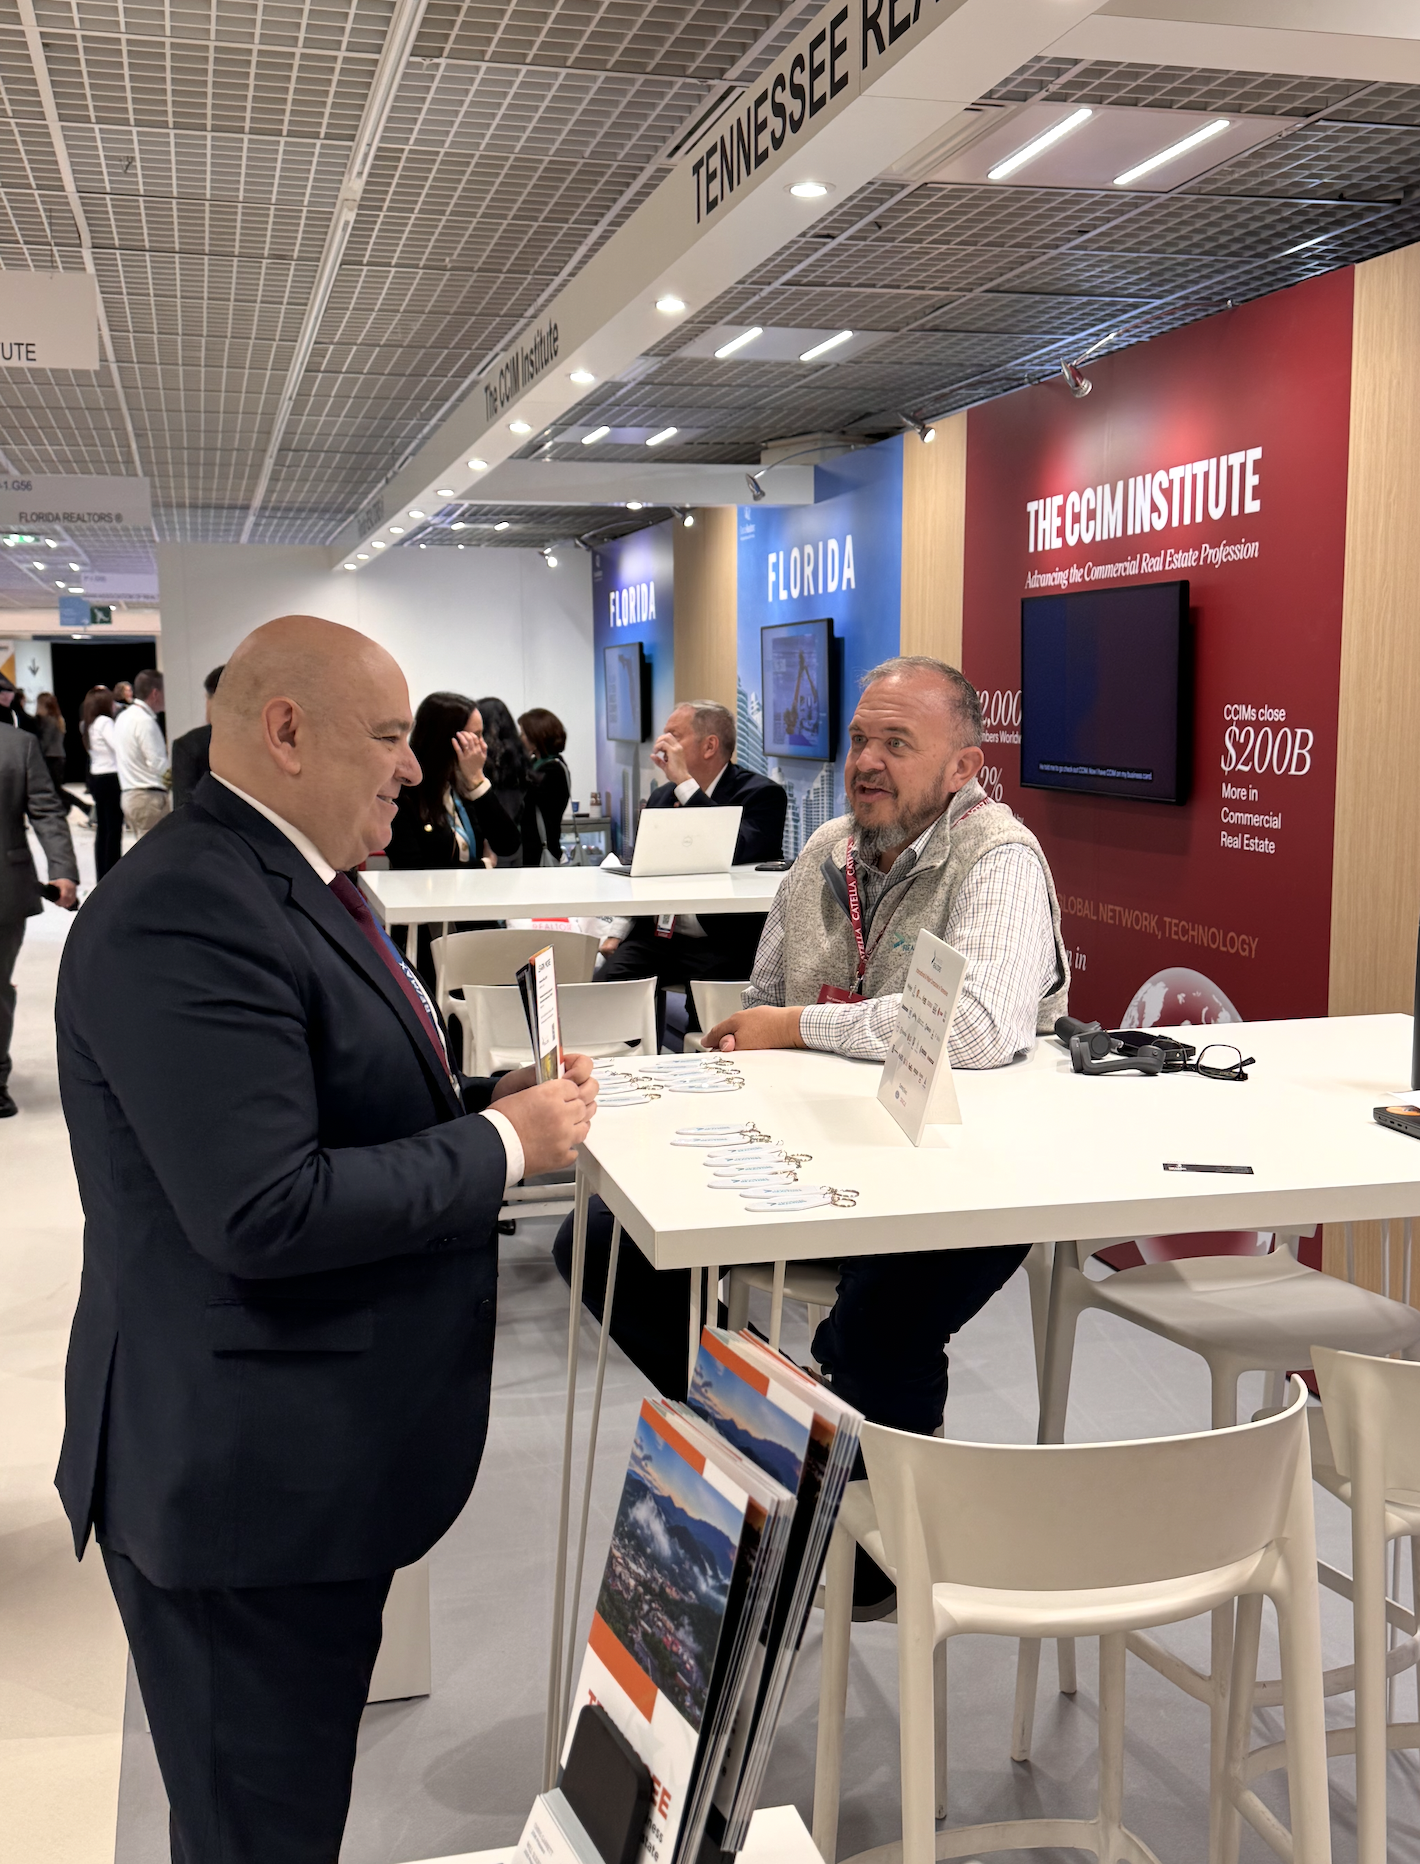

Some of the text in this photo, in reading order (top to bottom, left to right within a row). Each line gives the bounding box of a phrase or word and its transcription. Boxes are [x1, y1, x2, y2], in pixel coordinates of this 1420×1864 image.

[692, 5, 849, 224] TENNESSEE
[0, 342, 37, 361] UTE
[484, 318, 559, 422] The CCIM Institute
[19, 511, 60, 523] FLORIDA
[62, 512, 113, 524] REALTORS
[1026, 446, 1263, 553] THE CCIM INSTITUTE
[768, 534, 856, 603] FLORIDA
[1025, 538, 1259, 589] Advancing the Commercial Real Estate Profession
[609, 580, 657, 628] FLORIDA
[977, 690, 1023, 728] 2,000
[1224, 703, 1286, 722] CCIMs close
[1220, 720, 1314, 776] $200B
[980, 766, 1004, 802] 2%
[1221, 782, 1259, 801] More in
[1220, 806, 1282, 829] Commercial
[1220, 831, 1276, 854] Real Estate
[848, 881, 861, 921] CATELLA
[1057, 893, 1259, 959] GLOBAL NETWORK, TECHNOLOGY
[1074, 946, 1087, 971] in
[398, 961, 431, 1013] RE/MAX
